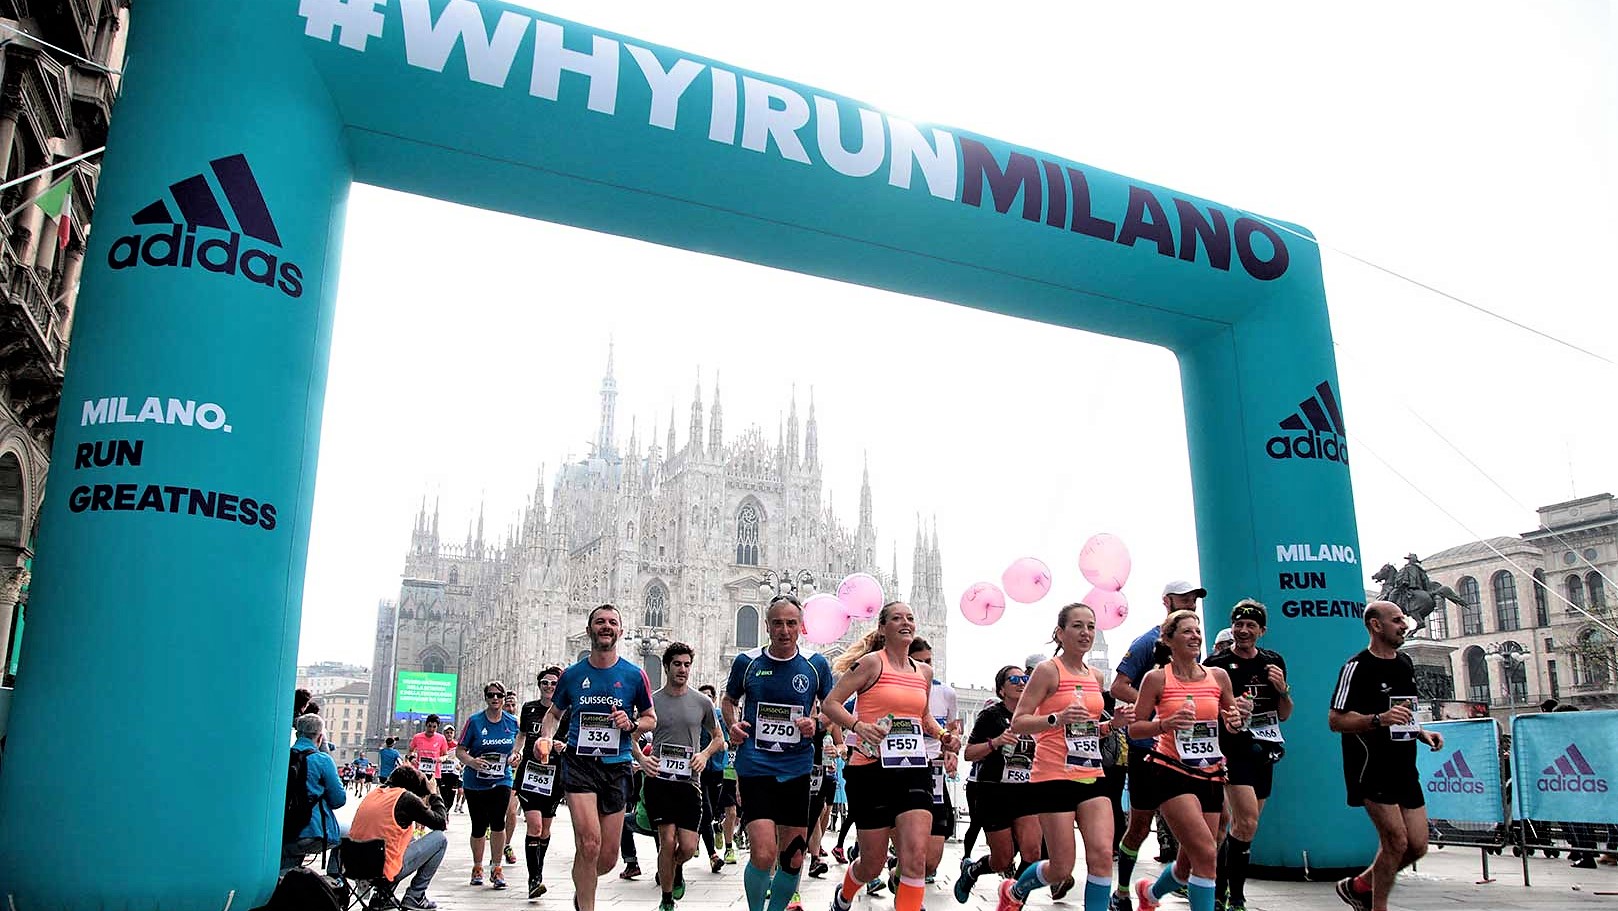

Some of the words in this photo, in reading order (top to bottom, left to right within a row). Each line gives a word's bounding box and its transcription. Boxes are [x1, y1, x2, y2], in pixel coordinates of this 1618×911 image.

[108, 223, 303, 298] adidas
[81, 397, 233, 433] MILANO.
[75, 440, 144, 469] RUN
[69, 484, 277, 530] GREATNESS
[1276, 544, 1358, 564] MILANO.
[1279, 572, 1326, 590] RUN
[588, 731, 610, 742] 336
[762, 723, 795, 737] 2750
[887, 738, 918, 750] F557
[1182, 742, 1214, 753] F536
[666, 760, 685, 770] 1715
[527, 774, 550, 785] F563
[1427, 776, 1485, 794] adidas
[1537, 774, 1609, 793] adidas
